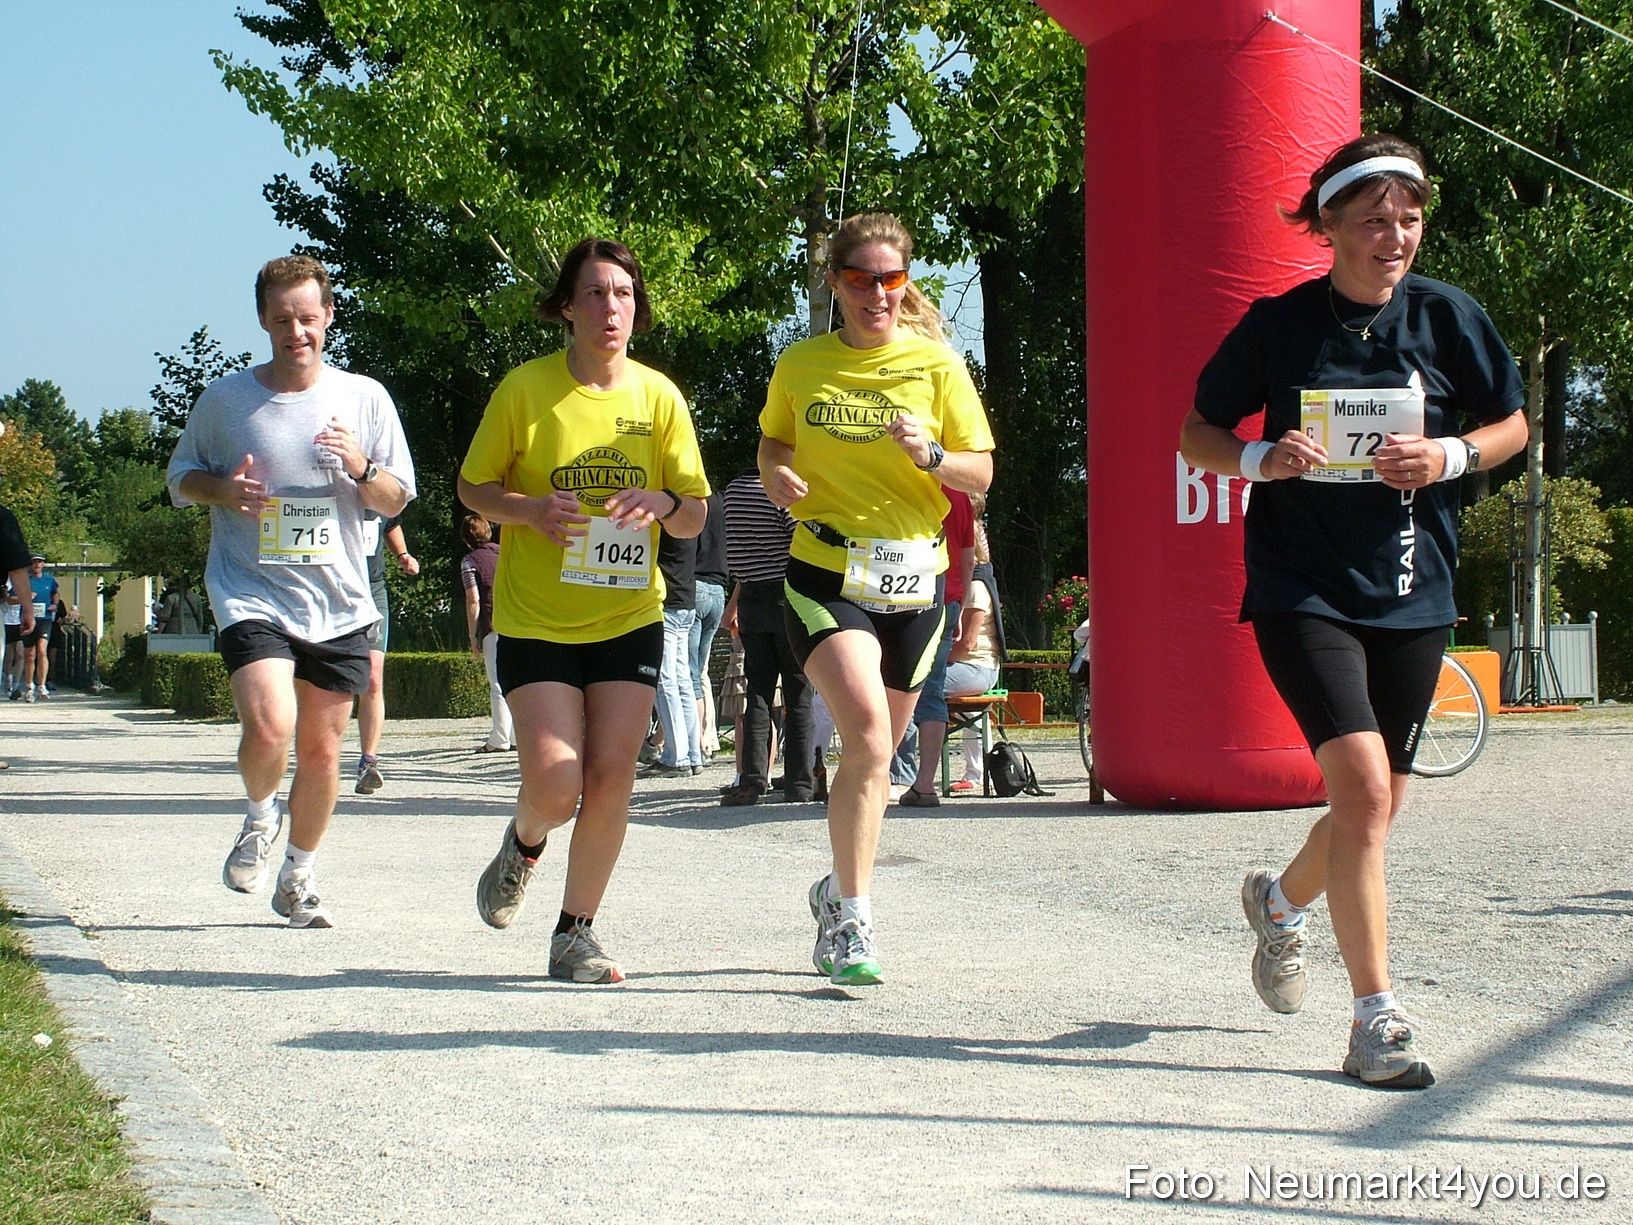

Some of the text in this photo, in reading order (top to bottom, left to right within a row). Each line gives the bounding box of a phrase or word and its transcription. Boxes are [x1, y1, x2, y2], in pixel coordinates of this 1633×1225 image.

[832, 391, 890, 408] PIZZERIA
[1334, 399, 1387, 417] Monika
[817, 405, 899, 425] FRANCESCO
[1306, 427, 1314, 439] C
[575, 448, 629, 468] PIZZERIA
[564, 468, 638, 488] FRANCESCO
[283, 503, 331, 517] Christian
[292, 527, 330, 546] 715
[594, 542, 645, 566] 1042
[874, 546, 904, 563] Sven
[849, 565, 856, 577] A
[879, 574, 921, 595] 822
